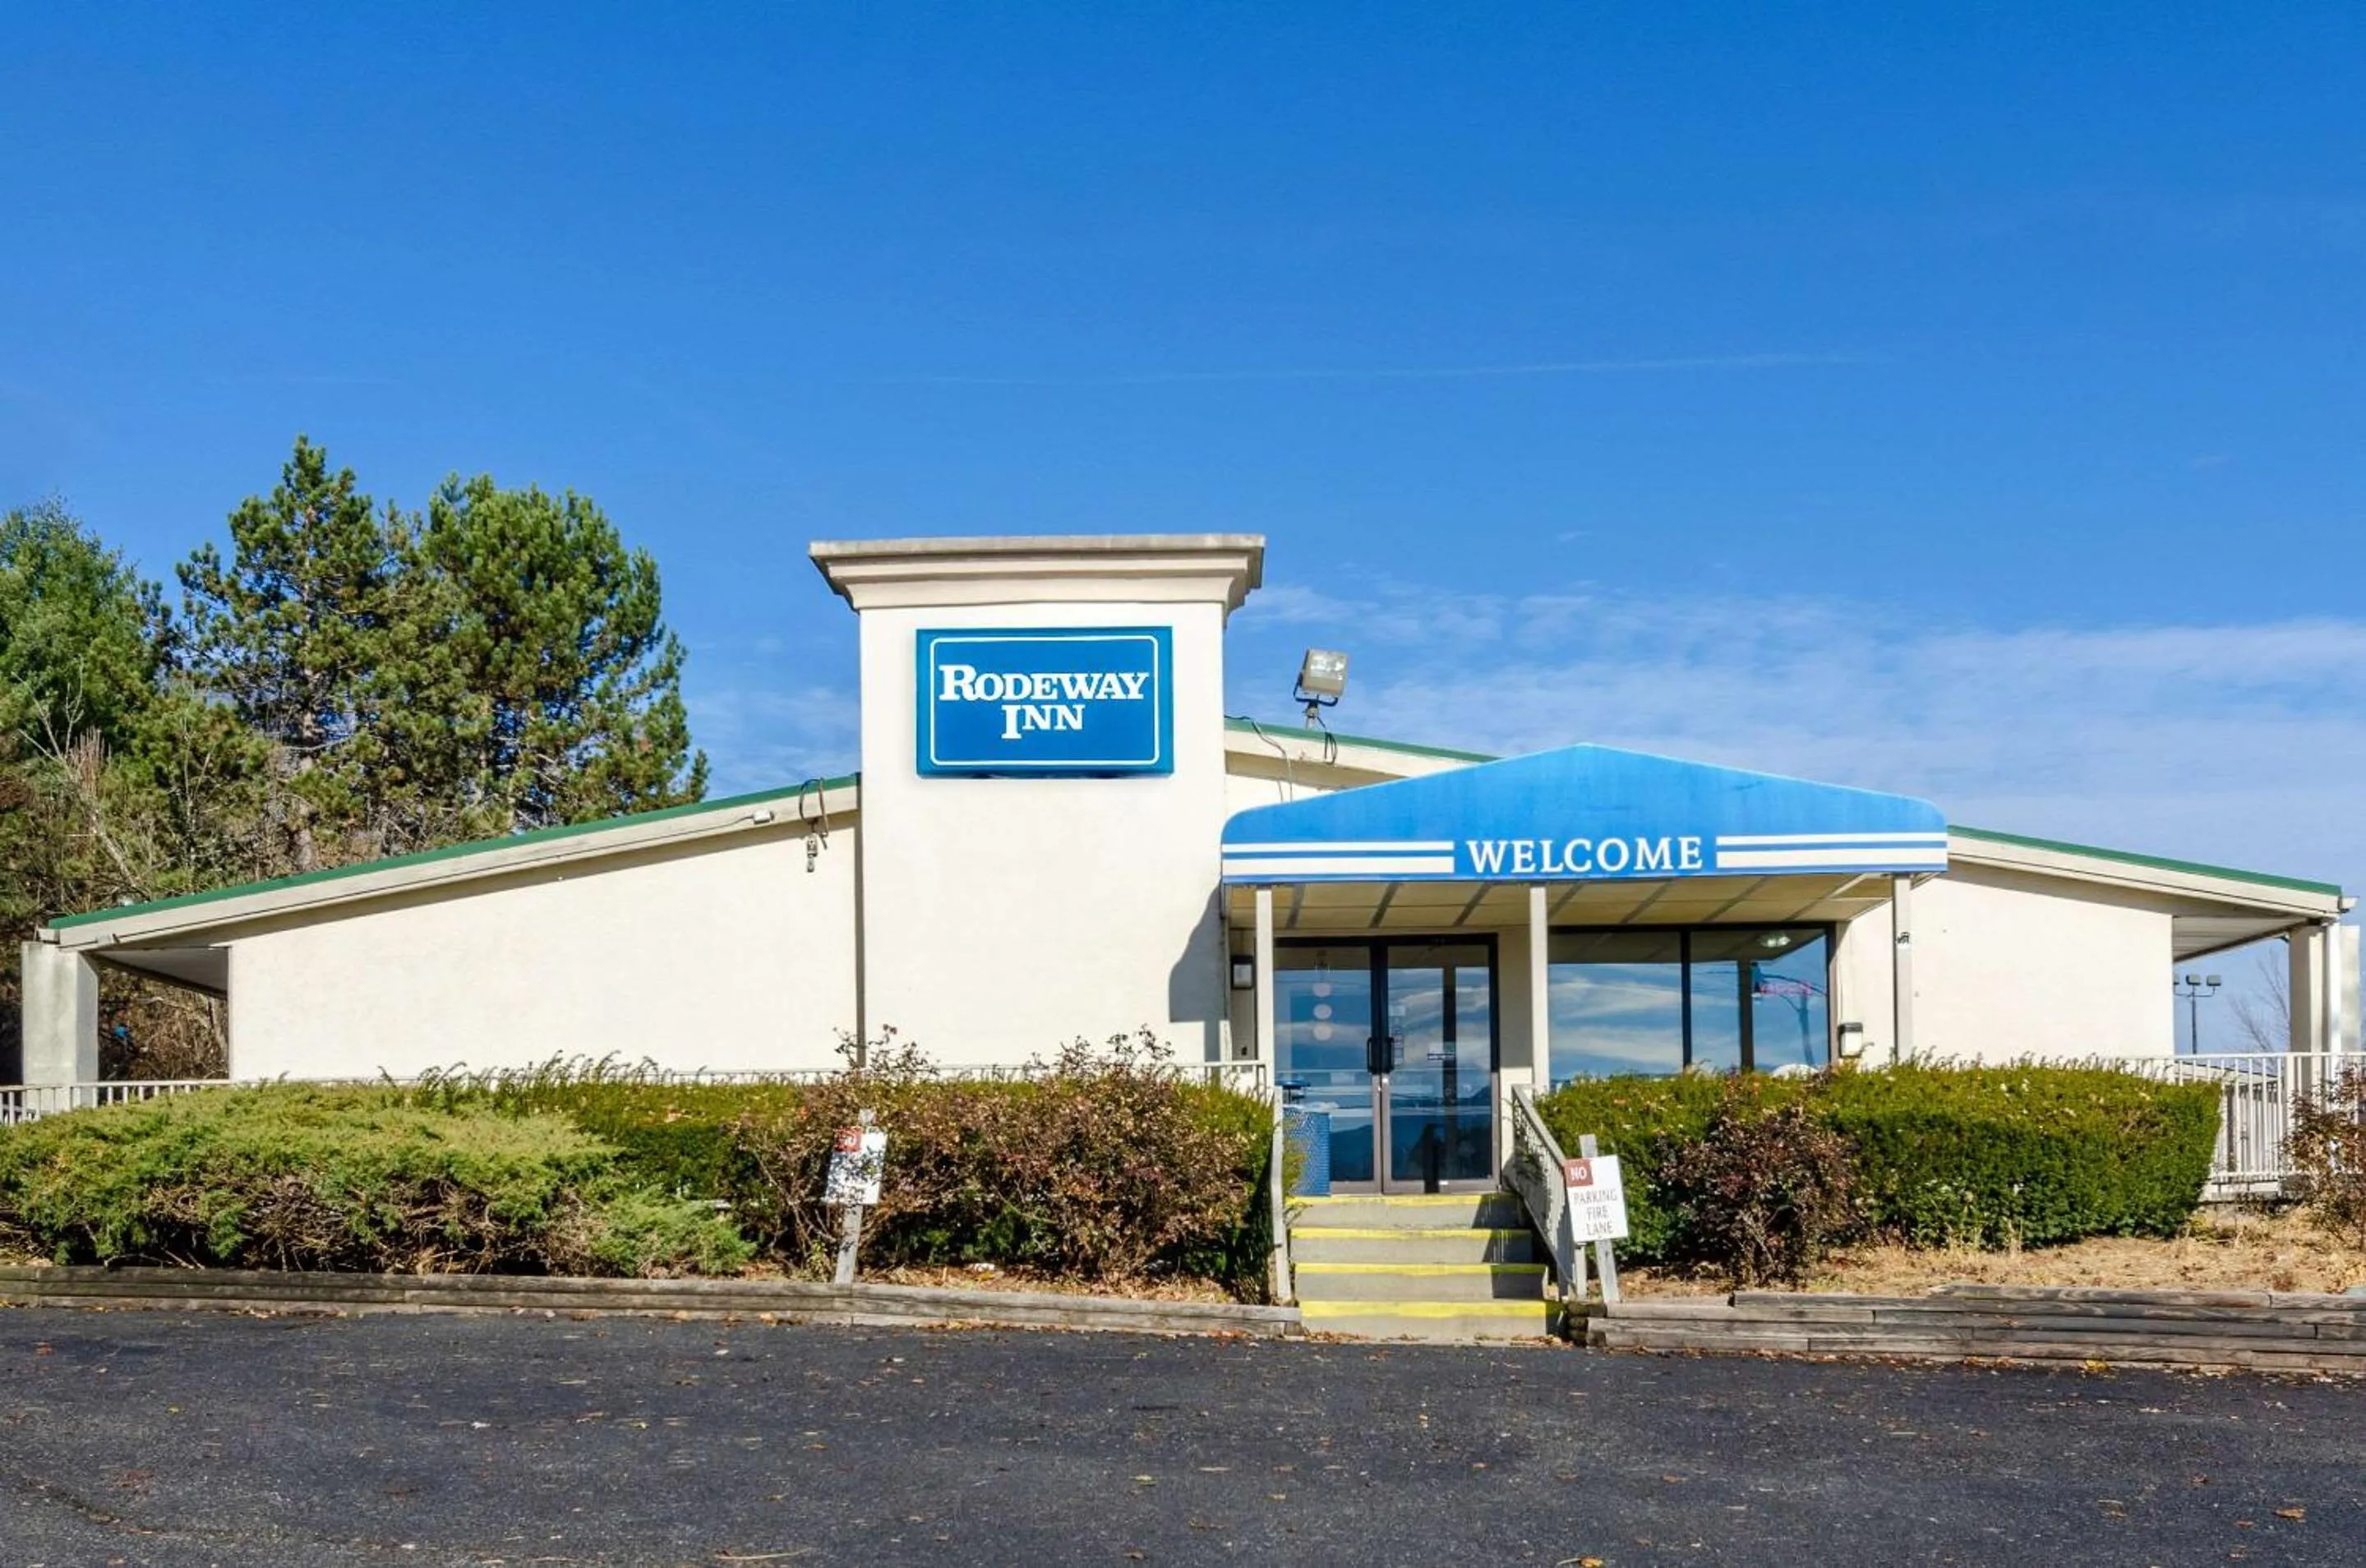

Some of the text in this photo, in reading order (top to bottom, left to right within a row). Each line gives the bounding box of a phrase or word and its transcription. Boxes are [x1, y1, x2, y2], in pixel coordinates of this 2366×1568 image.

[939, 664, 1149, 701] RODEWAY
[1001, 704, 1086, 740] INN
[1466, 836, 1704, 874] WELCOME
[1570, 1166, 1588, 1181] NO
[1573, 1188, 1618, 1206] PARKING
[1586, 1206, 1608, 1221] FIRE
[1586, 1221, 1614, 1236] LANE
